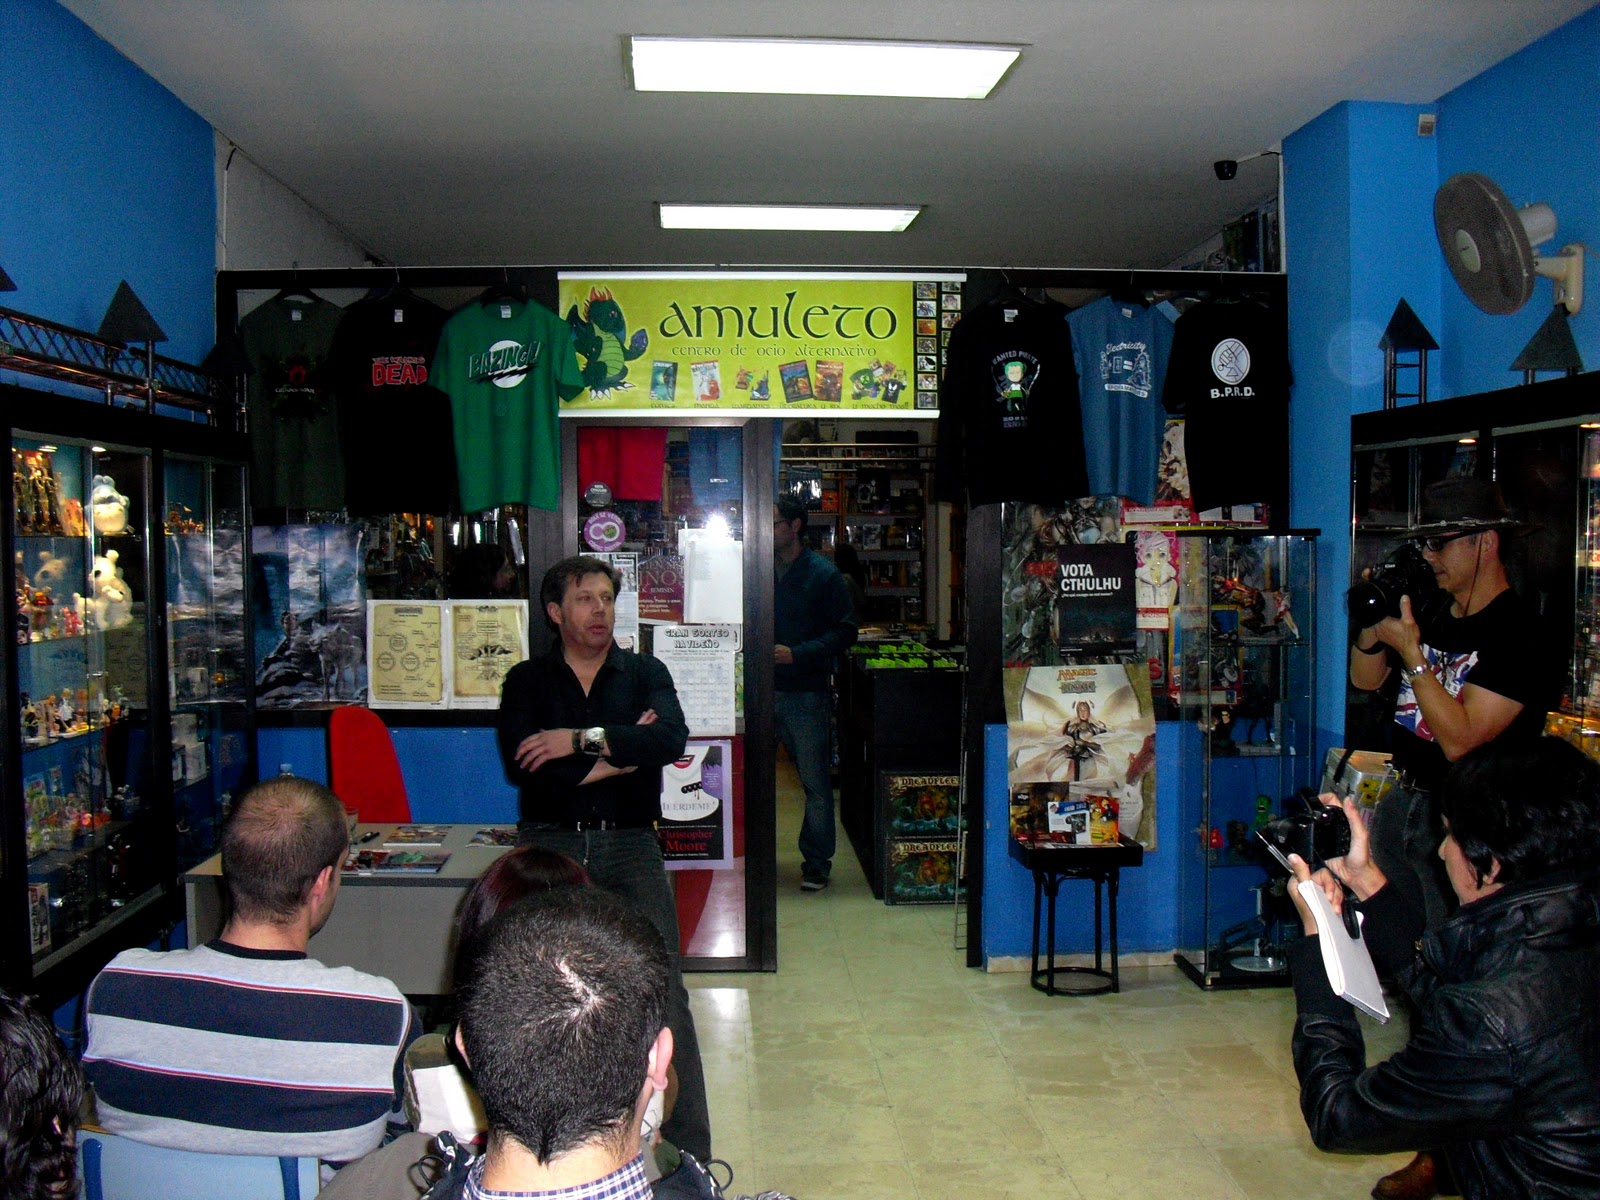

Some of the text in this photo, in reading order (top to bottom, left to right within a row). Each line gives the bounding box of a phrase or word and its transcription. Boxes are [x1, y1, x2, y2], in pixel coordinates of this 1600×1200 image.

[731, 344, 747, 356] de
[757, 344, 786, 356] ocio
[372, 363, 428, 386] DEAD
[1061, 564, 1094, 577] VOTA
[1061, 577, 1122, 591] CTHULHU
[664, 629, 730, 638] GRAN SORTEO
[674, 638, 720, 649] NAVIDEÑO
[665, 840, 708, 853] Moore
